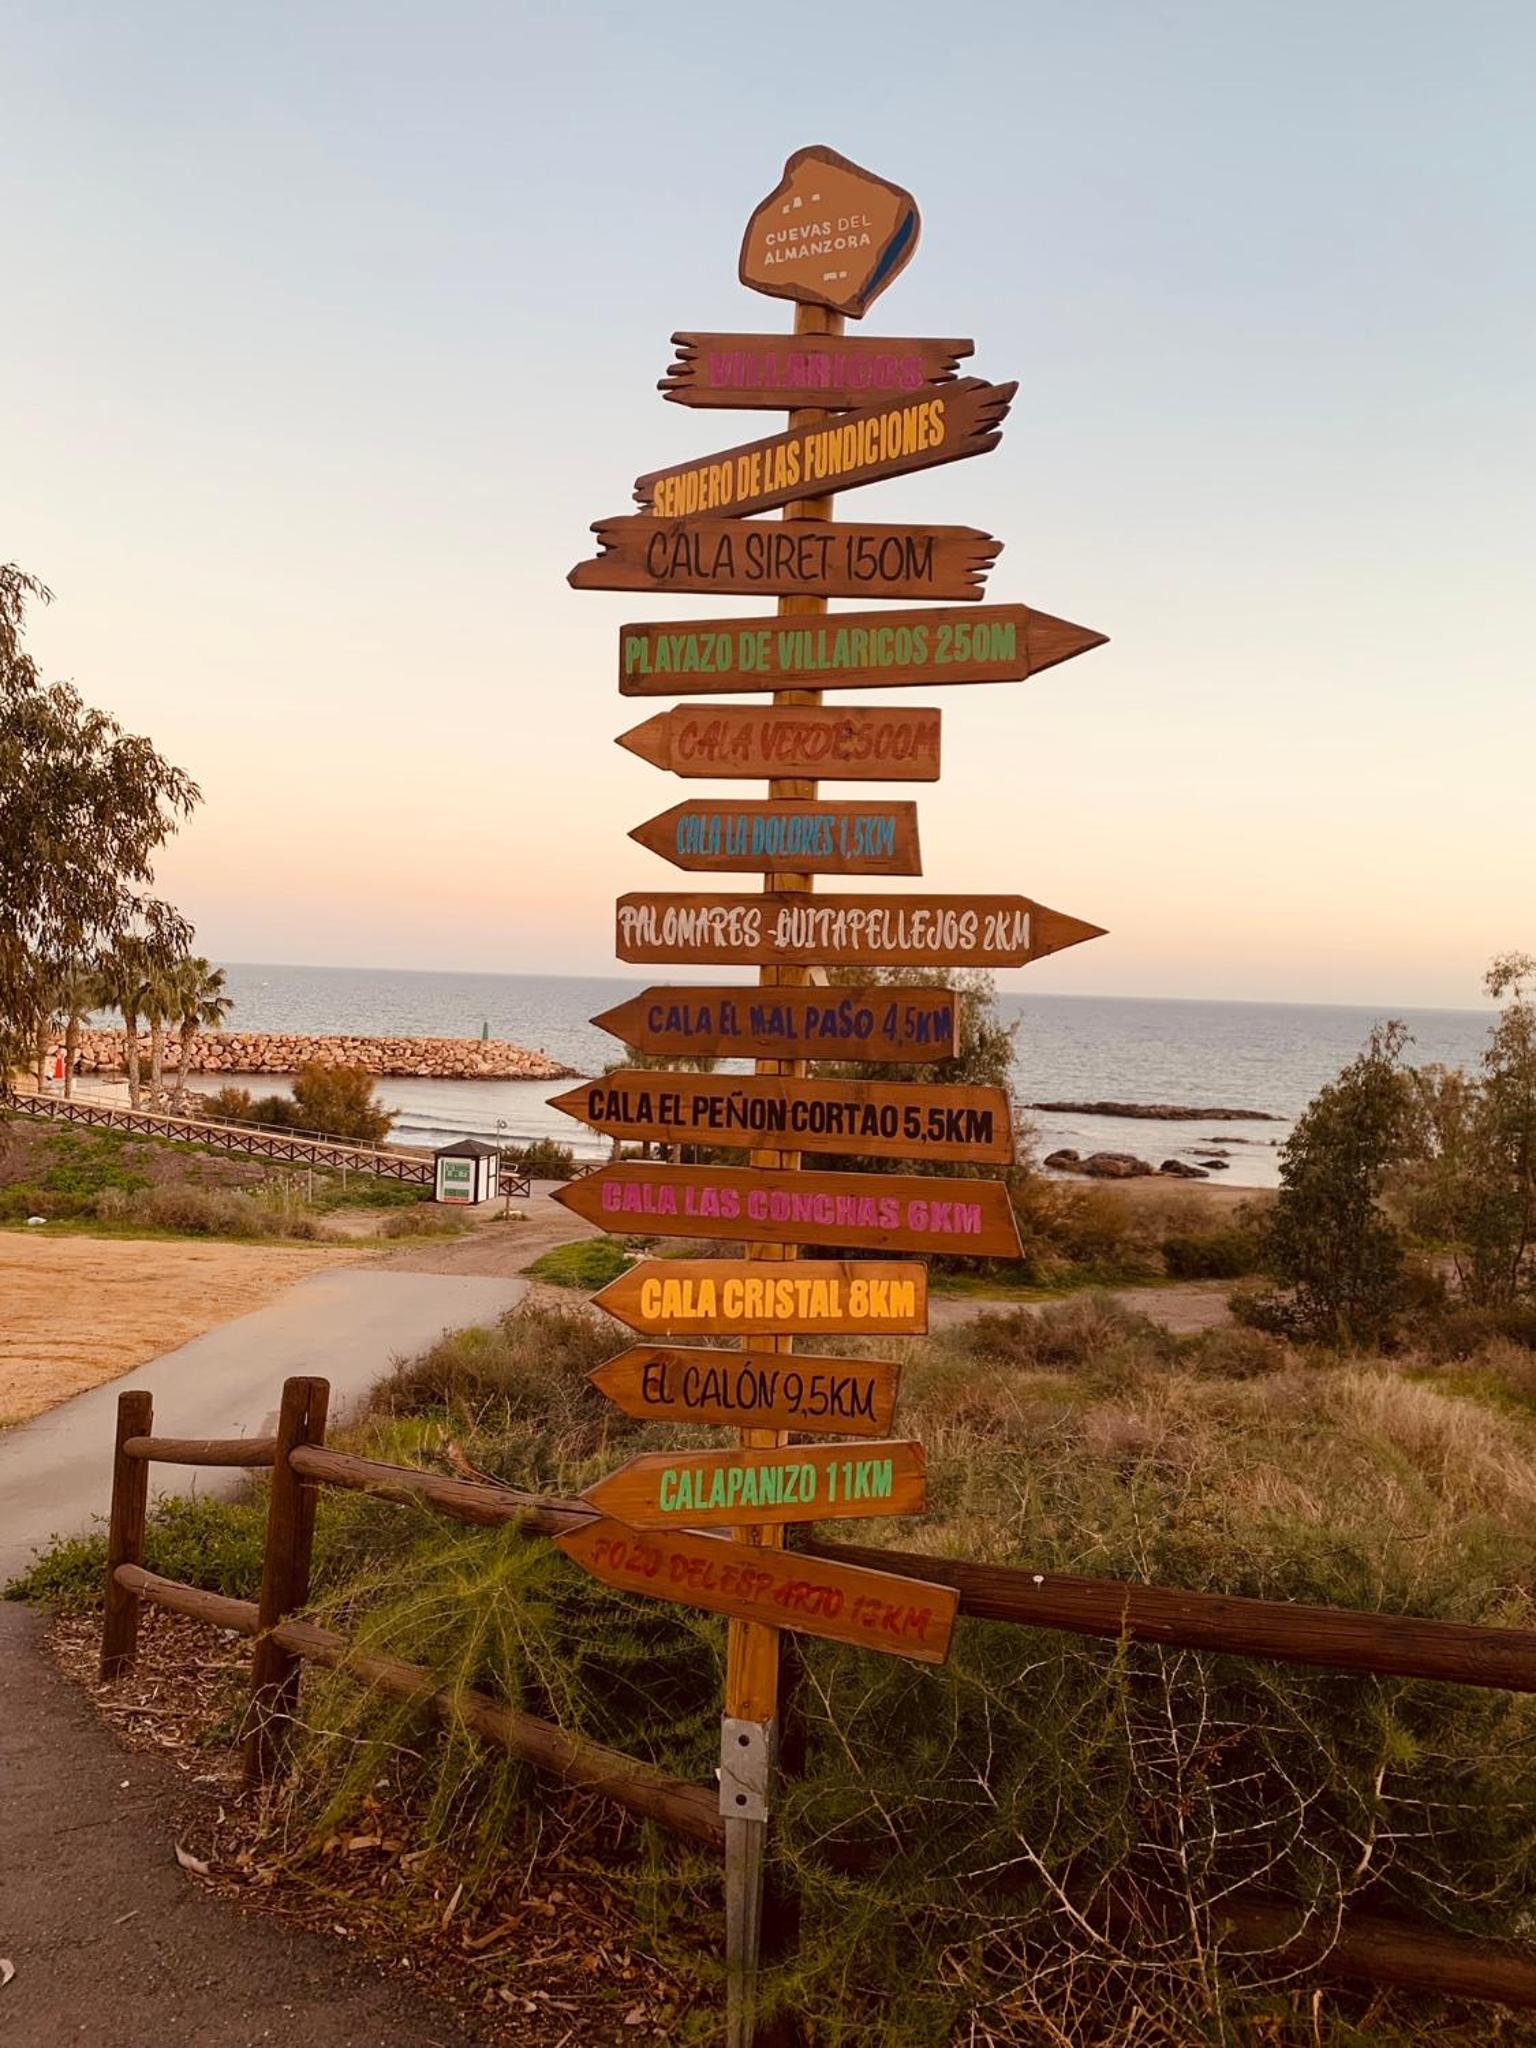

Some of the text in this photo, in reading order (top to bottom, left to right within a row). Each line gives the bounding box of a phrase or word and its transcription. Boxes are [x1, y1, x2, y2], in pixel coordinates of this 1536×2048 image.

[764, 233, 871, 266] ALMANZORA
[765, 214, 872, 246] CUEVAS DEL
[709, 351, 924, 389] VILLARICOS
[652, 399, 946, 518] SENDERO DE LAS FUNDICIONES
[646, 531, 934, 583] CALA SIRET 150M
[625, 622, 1017, 674] PLAYAZO DE VILLARICOS 250M
[678, 720, 752, 762] CALA
[677, 815, 720, 855] CALA
[726, 815, 747, 855] LA
[752, 815, 834, 855] DOLORES
[618, 905, 762, 947] PALOMARES
[982, 910, 1031, 951] 2KM
[648, 1004, 712, 1035] CALA
[719, 1001, 741, 1036] EL
[749, 1005, 798, 1040] MAL
[804, 1000, 875, 1040] PASO
[587, 1090, 994, 1144] CALA EL PEÑON CORTAO 5,5KM
[601, 1181, 983, 1236] CALA LAS CONCHAS 6KM
[641, 1278, 916, 1319] CALA CRISTAL 8KM
[642, 1361, 877, 1423] EL CALÓN 9,5KM
[659, 1459, 893, 1512] CALAPANIZO 11KM
